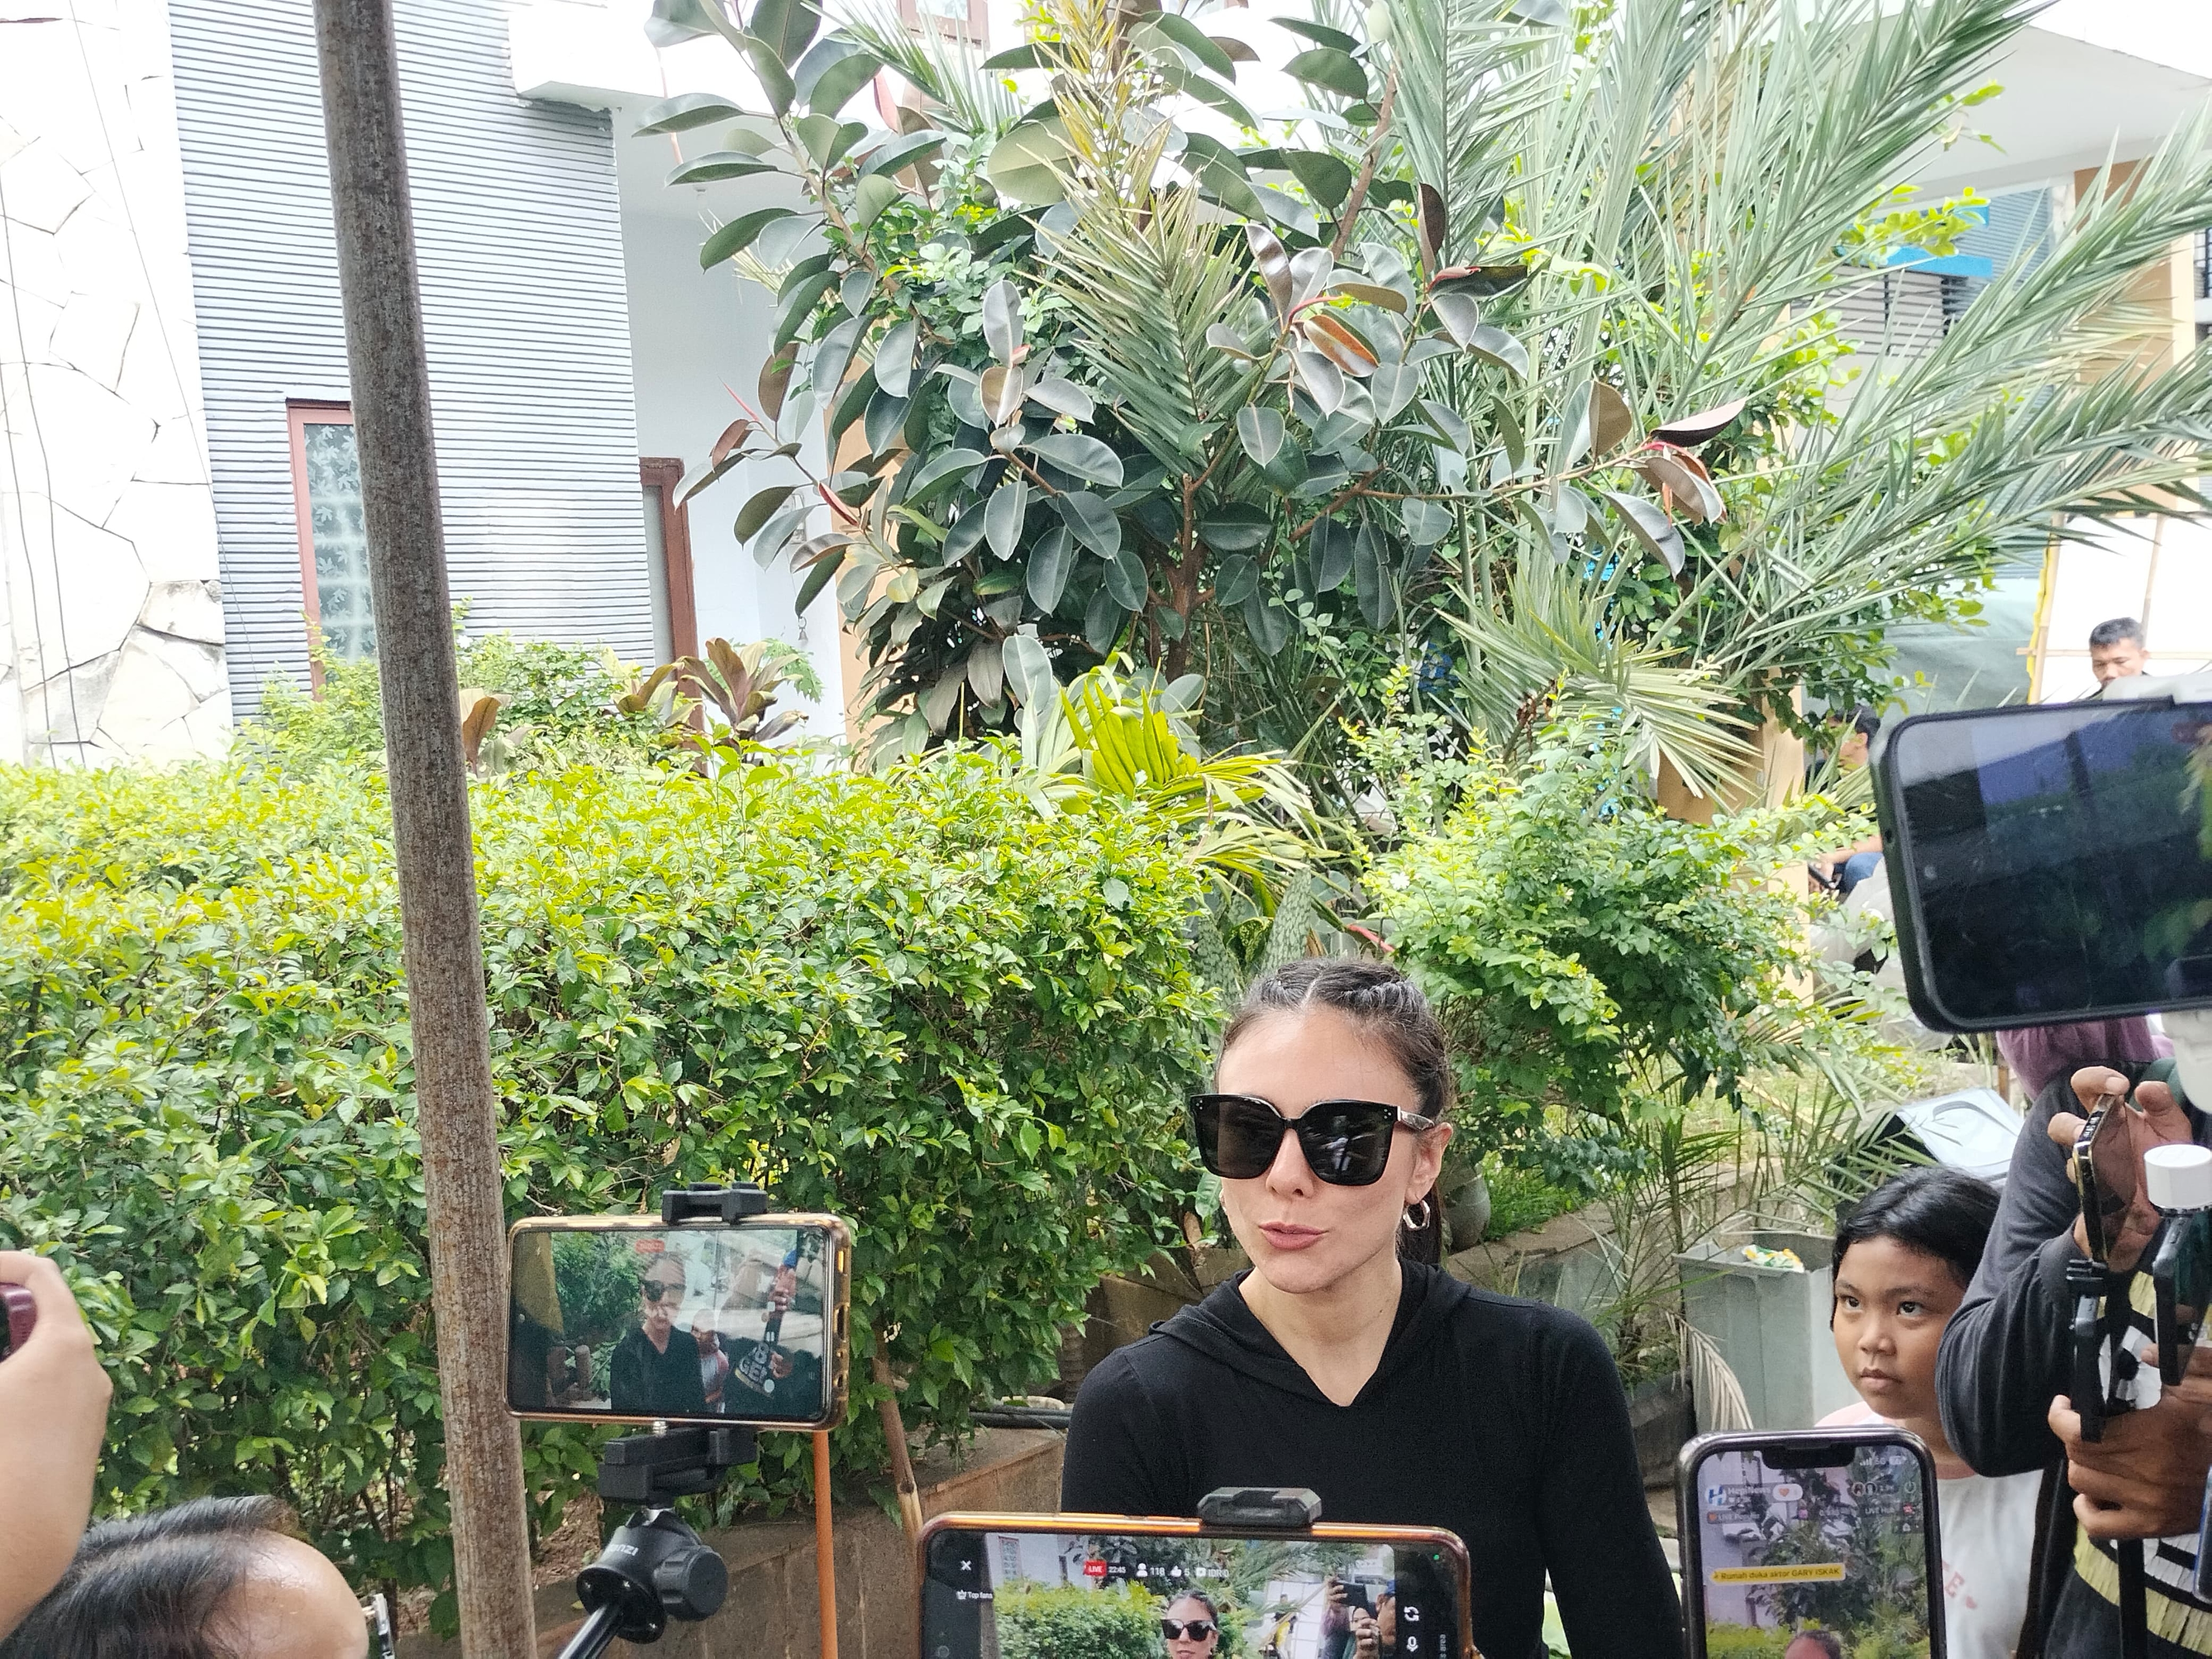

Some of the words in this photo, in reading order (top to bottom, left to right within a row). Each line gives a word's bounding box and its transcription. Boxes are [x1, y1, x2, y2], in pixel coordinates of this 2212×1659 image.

[1088, 1565, 1103, 1573] LIVE
[1108, 1566, 1126, 1574] 22:45
[1721, 1571, 1748, 1580] Rumah
[1815, 1567, 1840, 1575] ISKAK
[967, 1591, 979, 1600] Top
